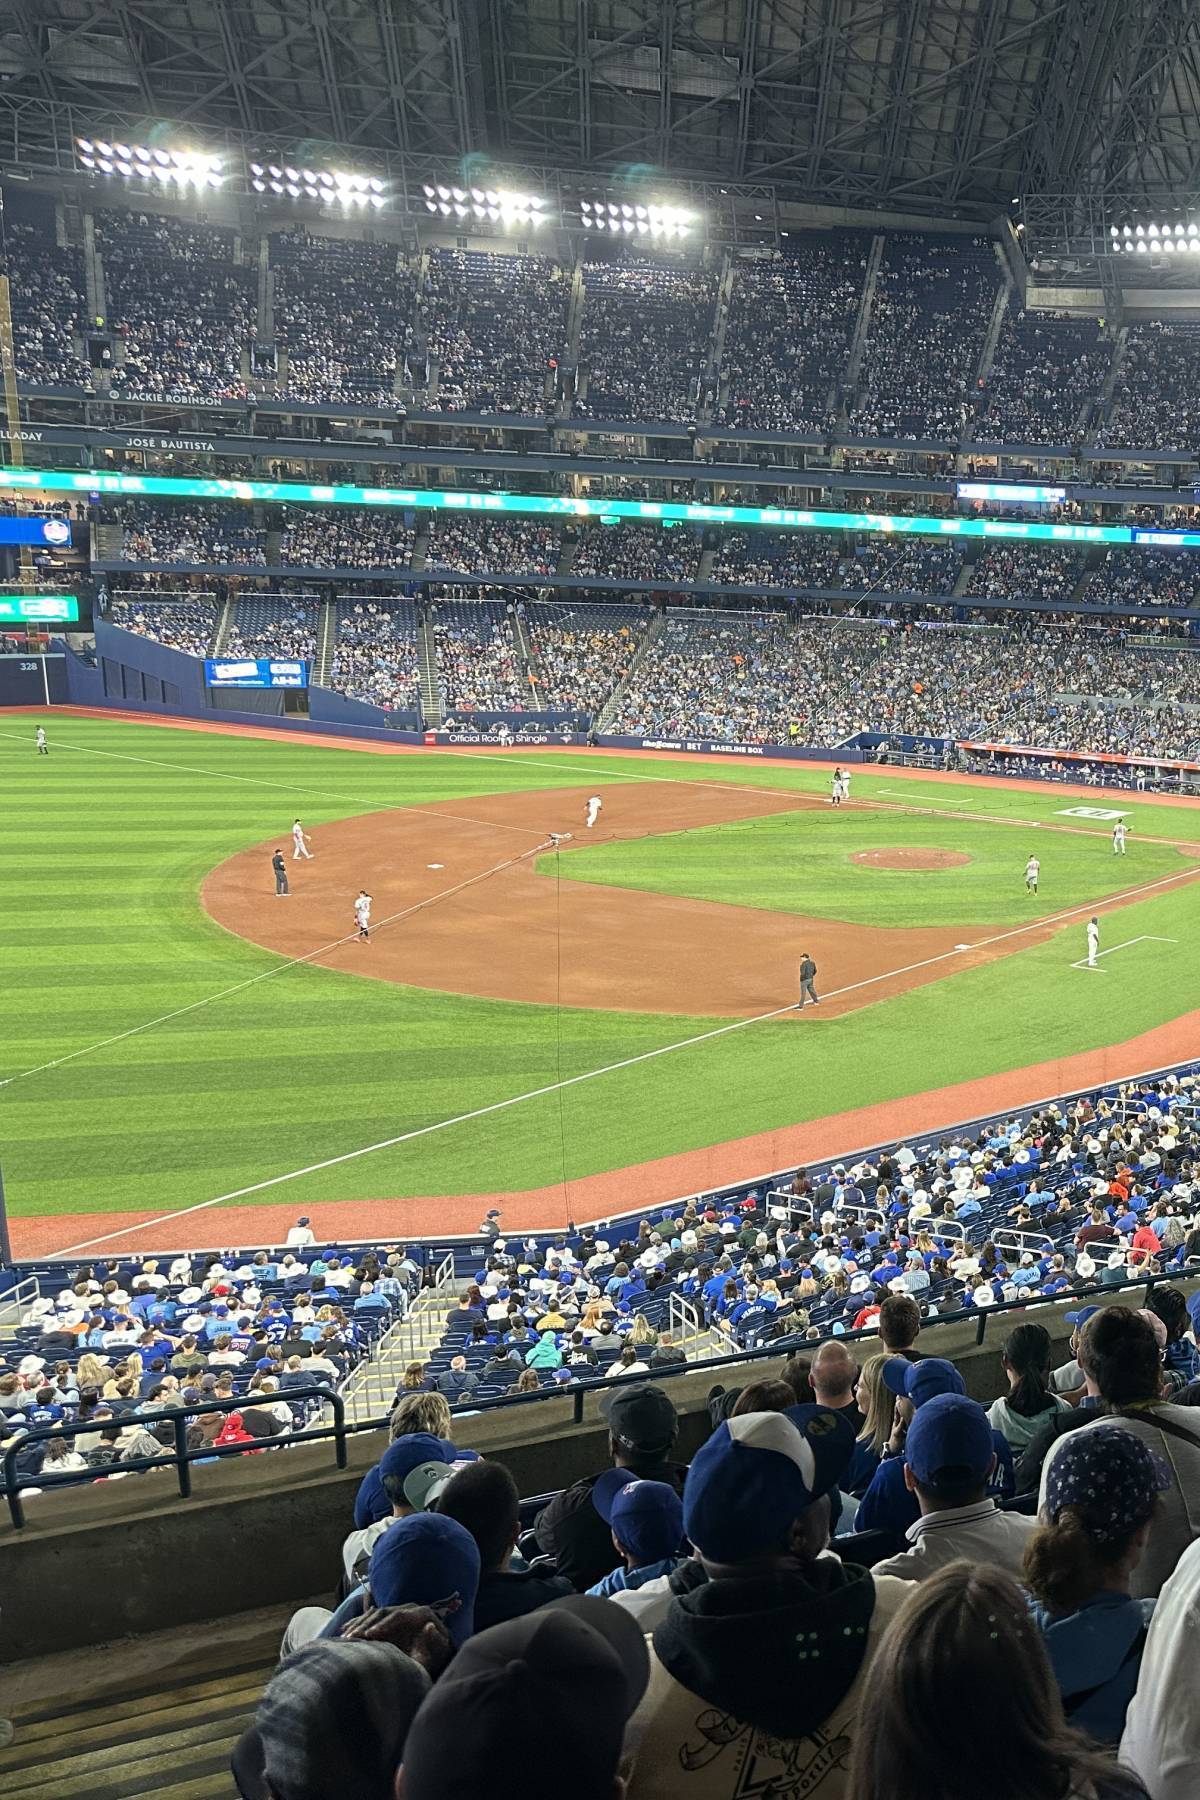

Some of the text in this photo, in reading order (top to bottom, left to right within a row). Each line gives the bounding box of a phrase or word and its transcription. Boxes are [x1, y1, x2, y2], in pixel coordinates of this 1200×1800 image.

[126, 391, 163, 402] JACKIE
[166, 393, 222, 406] ROBINSON
[127, 437, 215, 451] JOSÉ BAUTISTA
[20, 662, 37, 670] 328
[449, 734, 479, 743] Official
[516, 734, 548, 744] Shingle
[711, 744, 746, 753] BASELINE
[266, 1330, 287, 1341] 27
